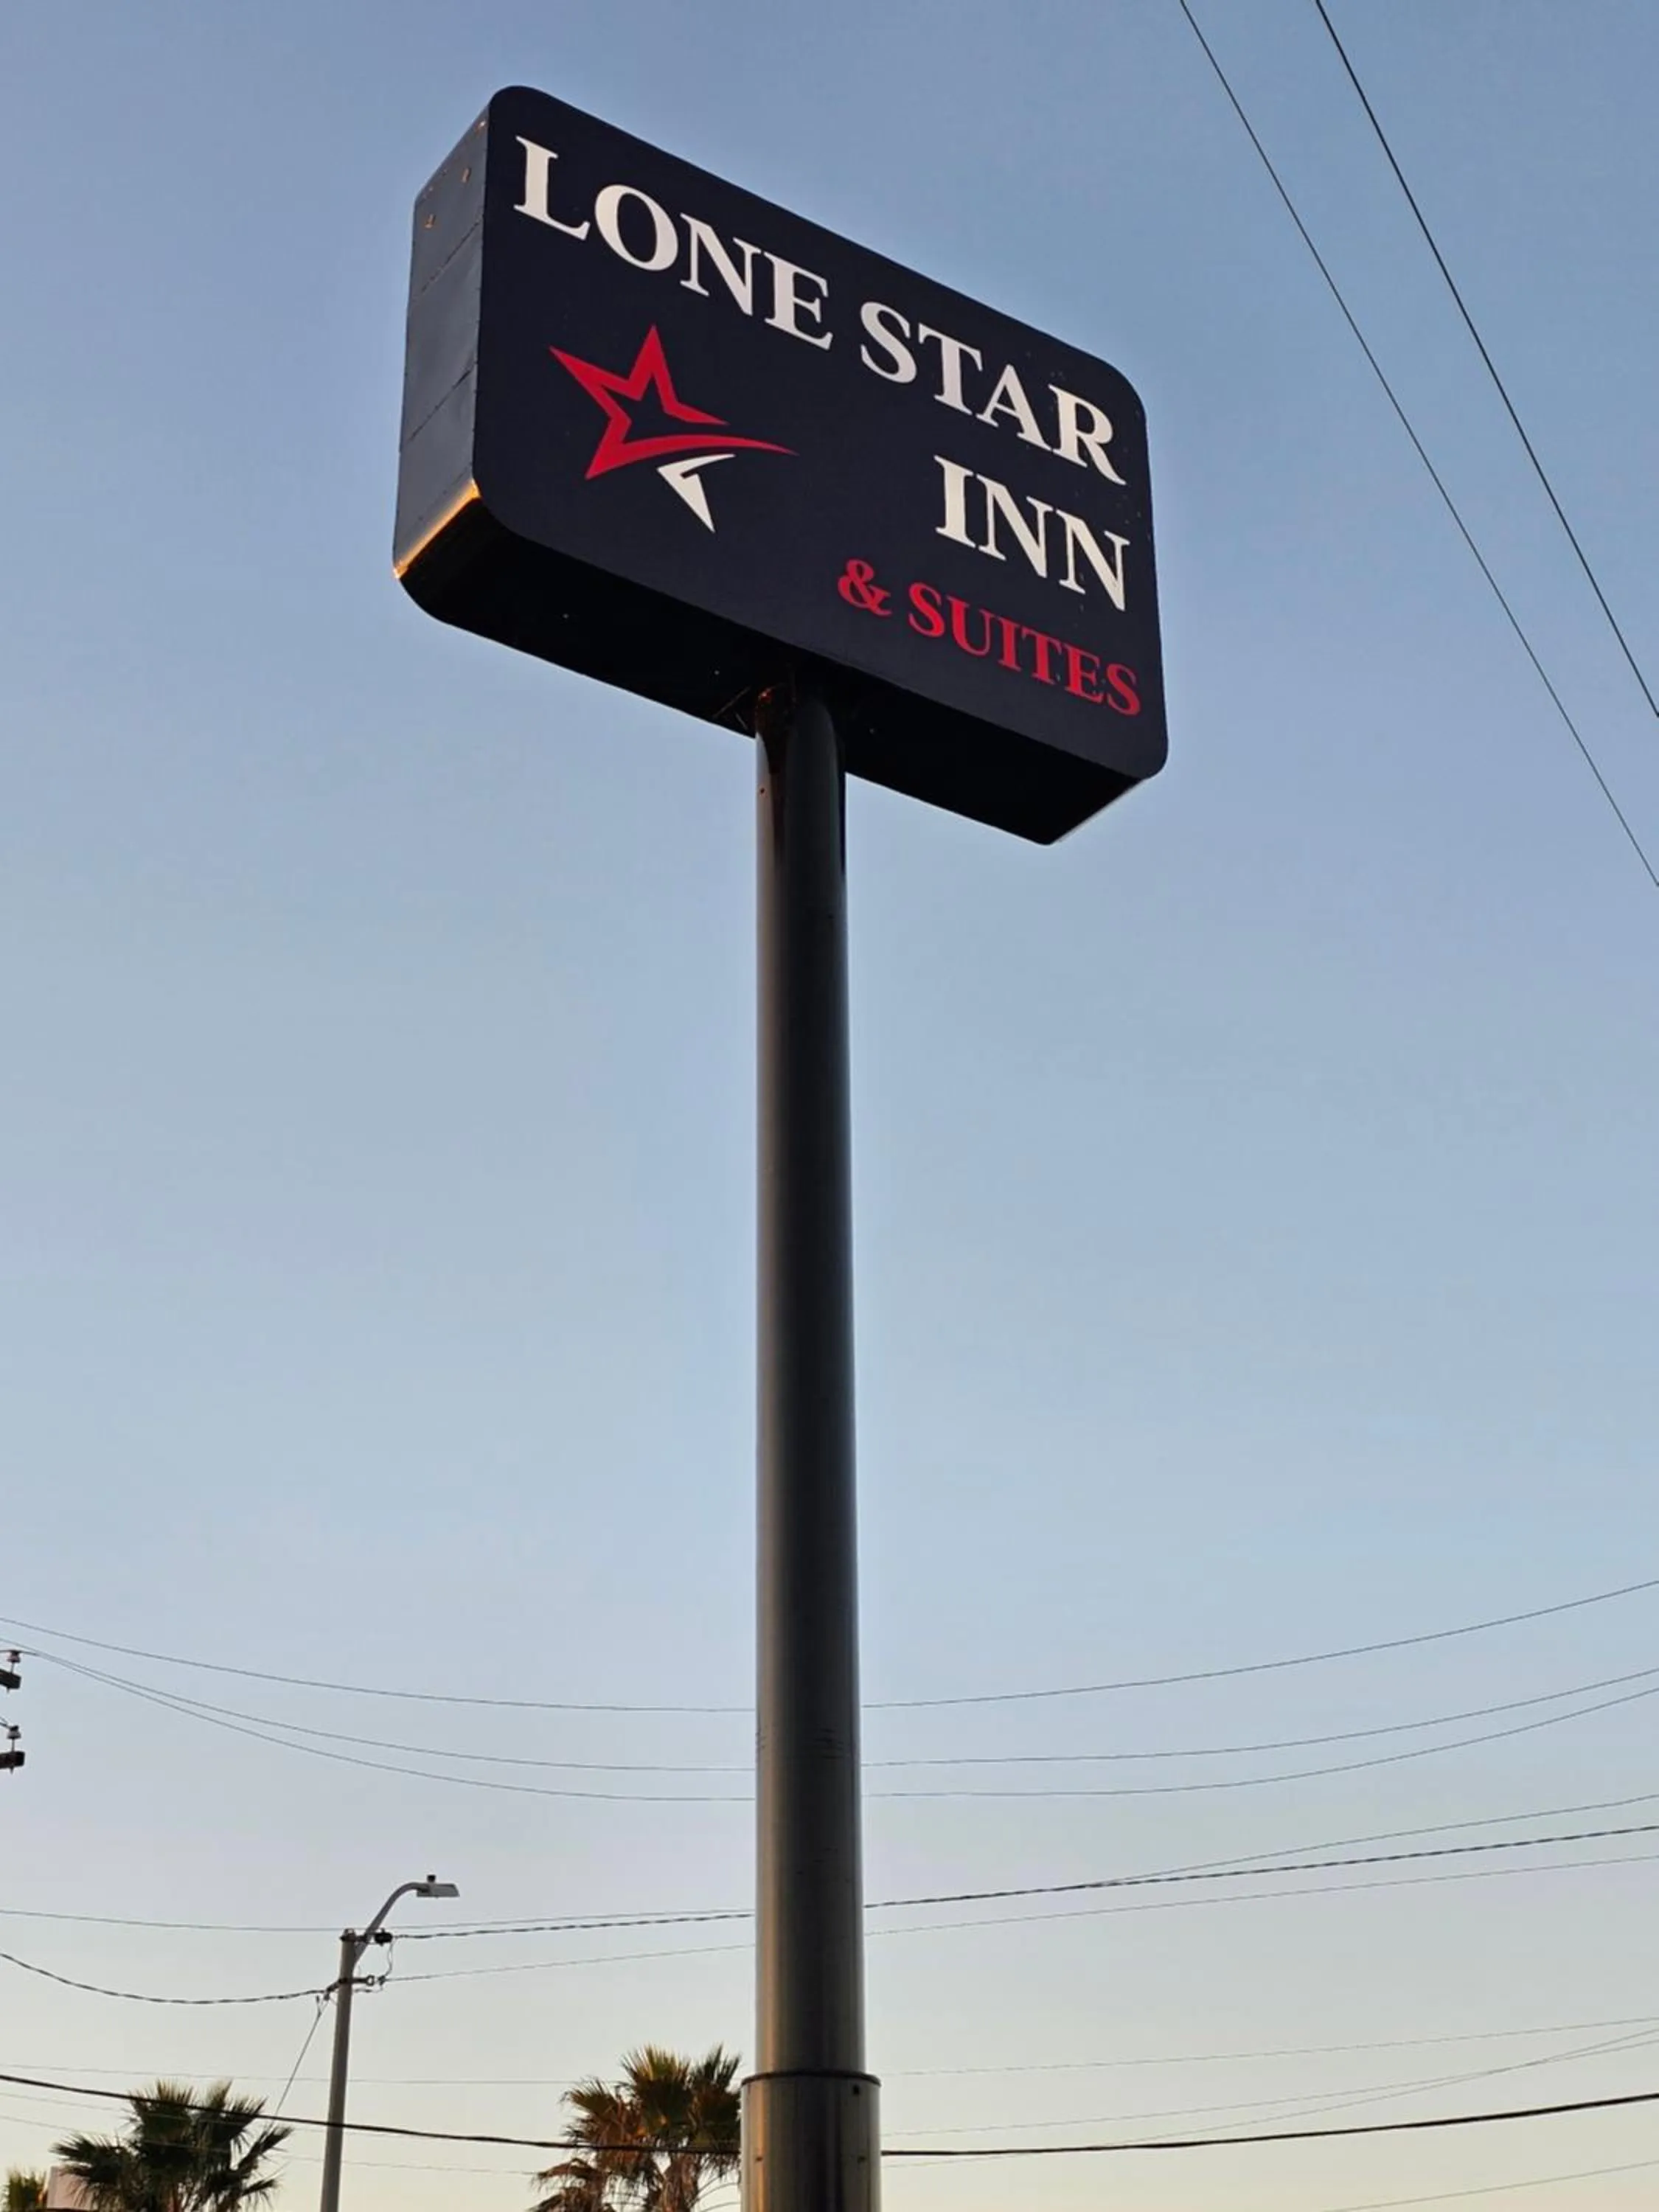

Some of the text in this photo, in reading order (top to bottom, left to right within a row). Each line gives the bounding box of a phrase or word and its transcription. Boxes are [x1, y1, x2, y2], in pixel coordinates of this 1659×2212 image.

[514, 135, 1127, 484] LONE STAR
[933, 454, 1131, 611] INN
[838, 559, 1141, 717] & SUITES
